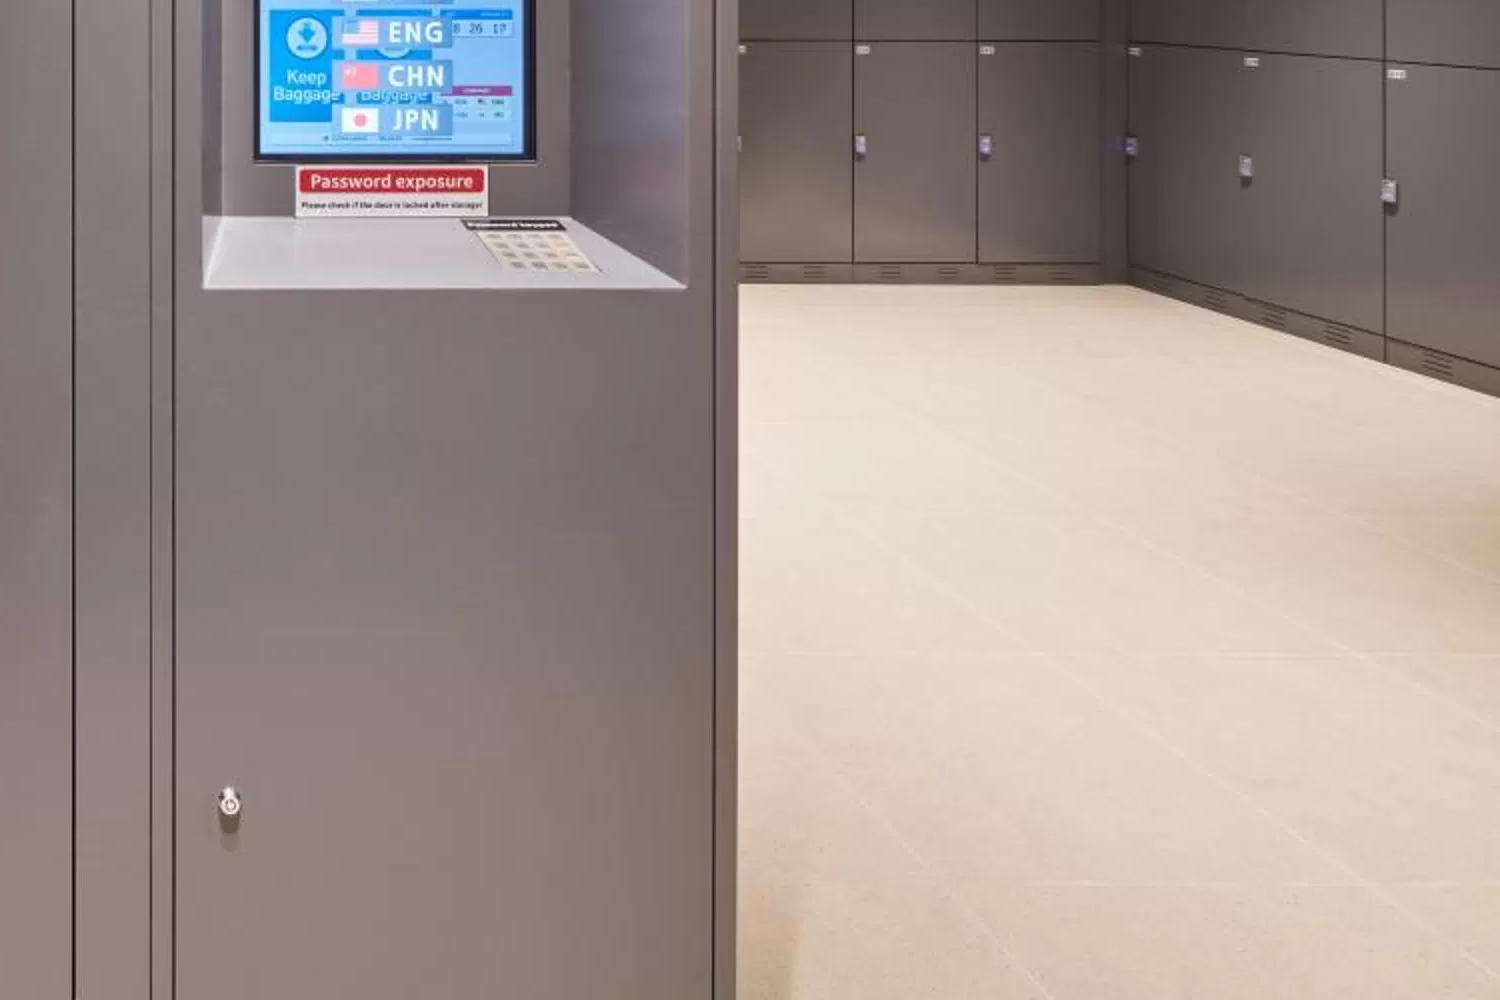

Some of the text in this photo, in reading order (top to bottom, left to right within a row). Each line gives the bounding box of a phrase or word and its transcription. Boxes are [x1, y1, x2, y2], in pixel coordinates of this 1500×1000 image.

[389, 21, 443, 44] ENG
[287, 69, 327, 85] Keep
[388, 65, 444, 88] CHN
[274, 87, 340, 105] Baggage
[393, 109, 438, 131] JPN
[311, 174, 473, 192] Password exposure
[301, 201, 326, 209] Please
